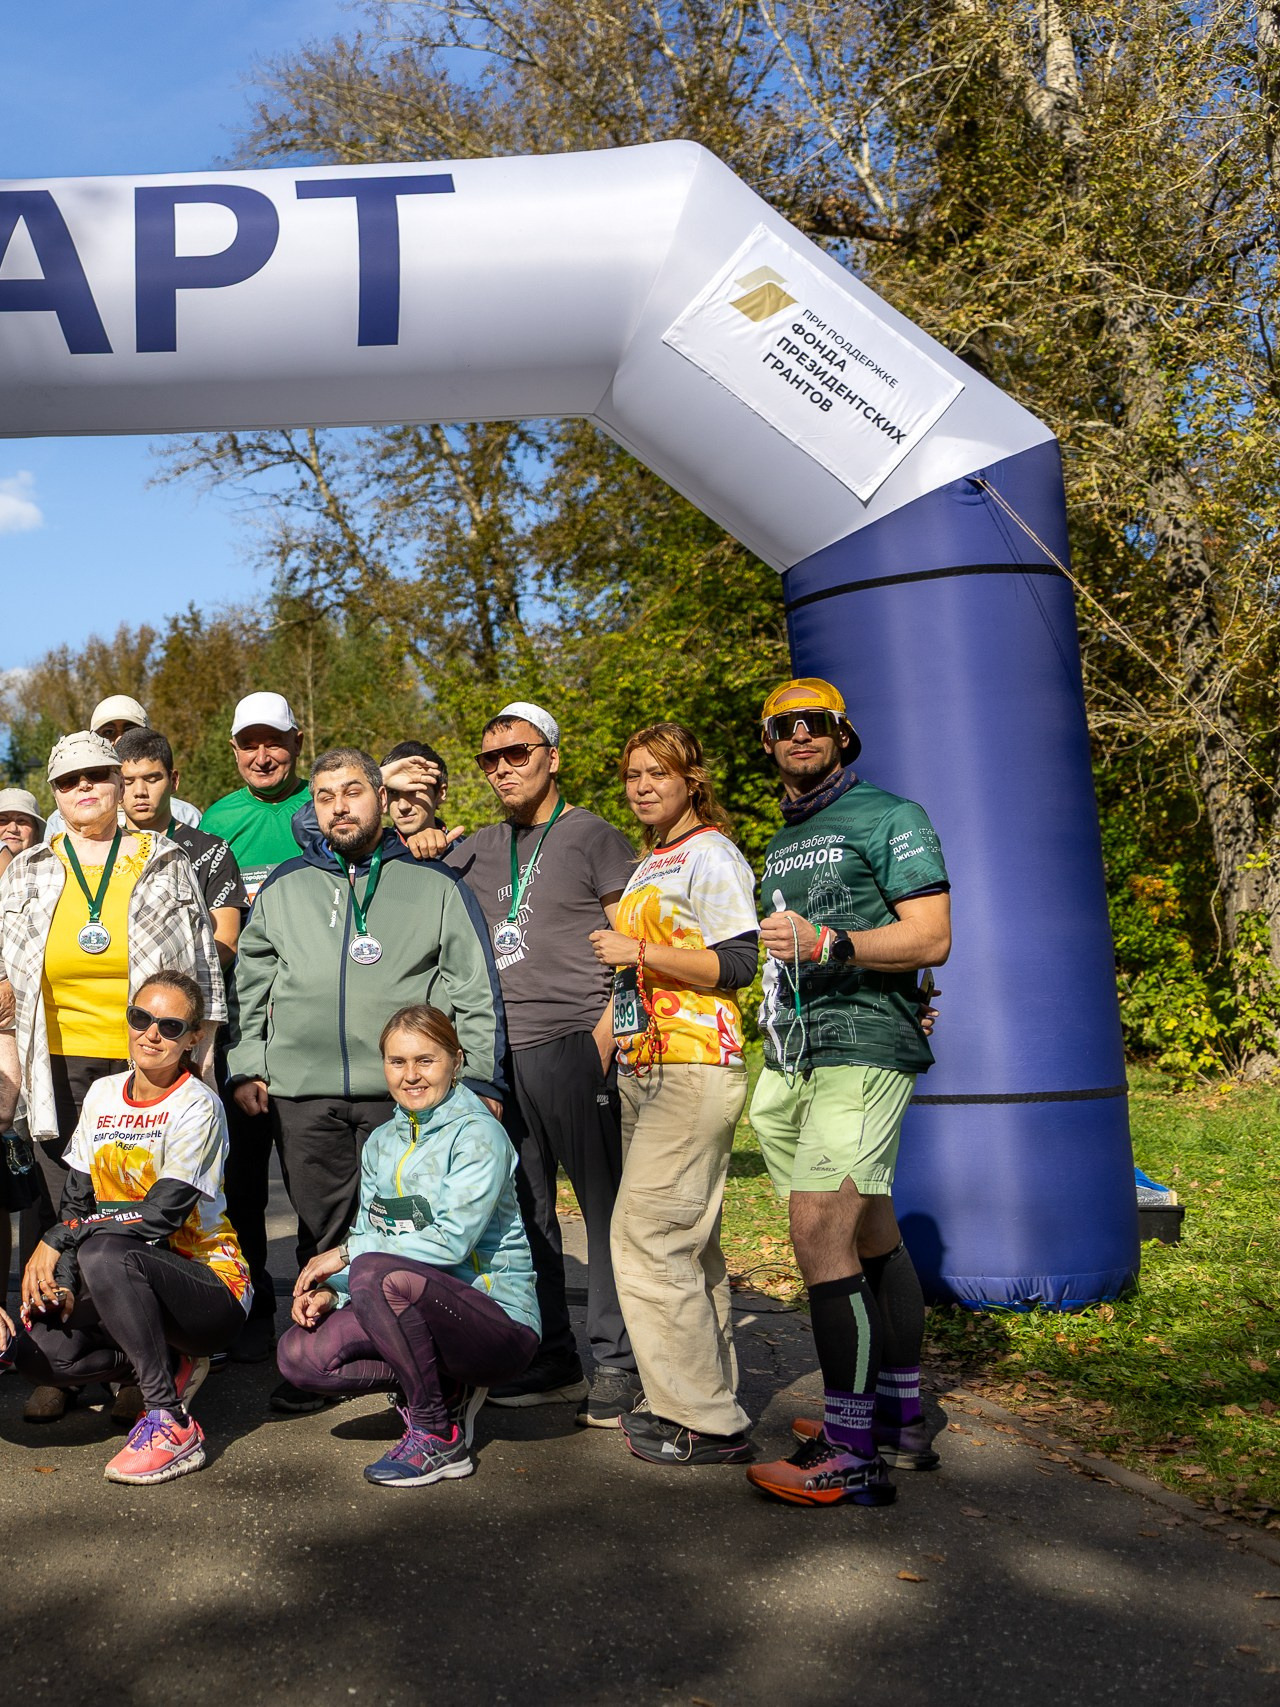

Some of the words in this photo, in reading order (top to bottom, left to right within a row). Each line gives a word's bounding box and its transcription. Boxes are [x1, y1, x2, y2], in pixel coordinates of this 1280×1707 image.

[791, 322, 847, 372] ФОНДА
[802, 309, 827, 331] ПРИ
[826, 326, 899, 389] ПОДДЕРЖКЕ
[762, 352, 834, 413] ГРАНТОВ
[776, 336, 907, 445] ПРЕЗИДЕНТСКИХ
[774, 842, 798, 859] серия
[800, 834, 845, 850] забегов
[889, 831, 913, 845] спорт
[893, 842, 909, 855] для
[767, 847, 844, 877] городов
[896, 846, 925, 862] жизни
[615, 1001, 635, 1029] 599
[115, 1141, 138, 1150] АБЕГ
